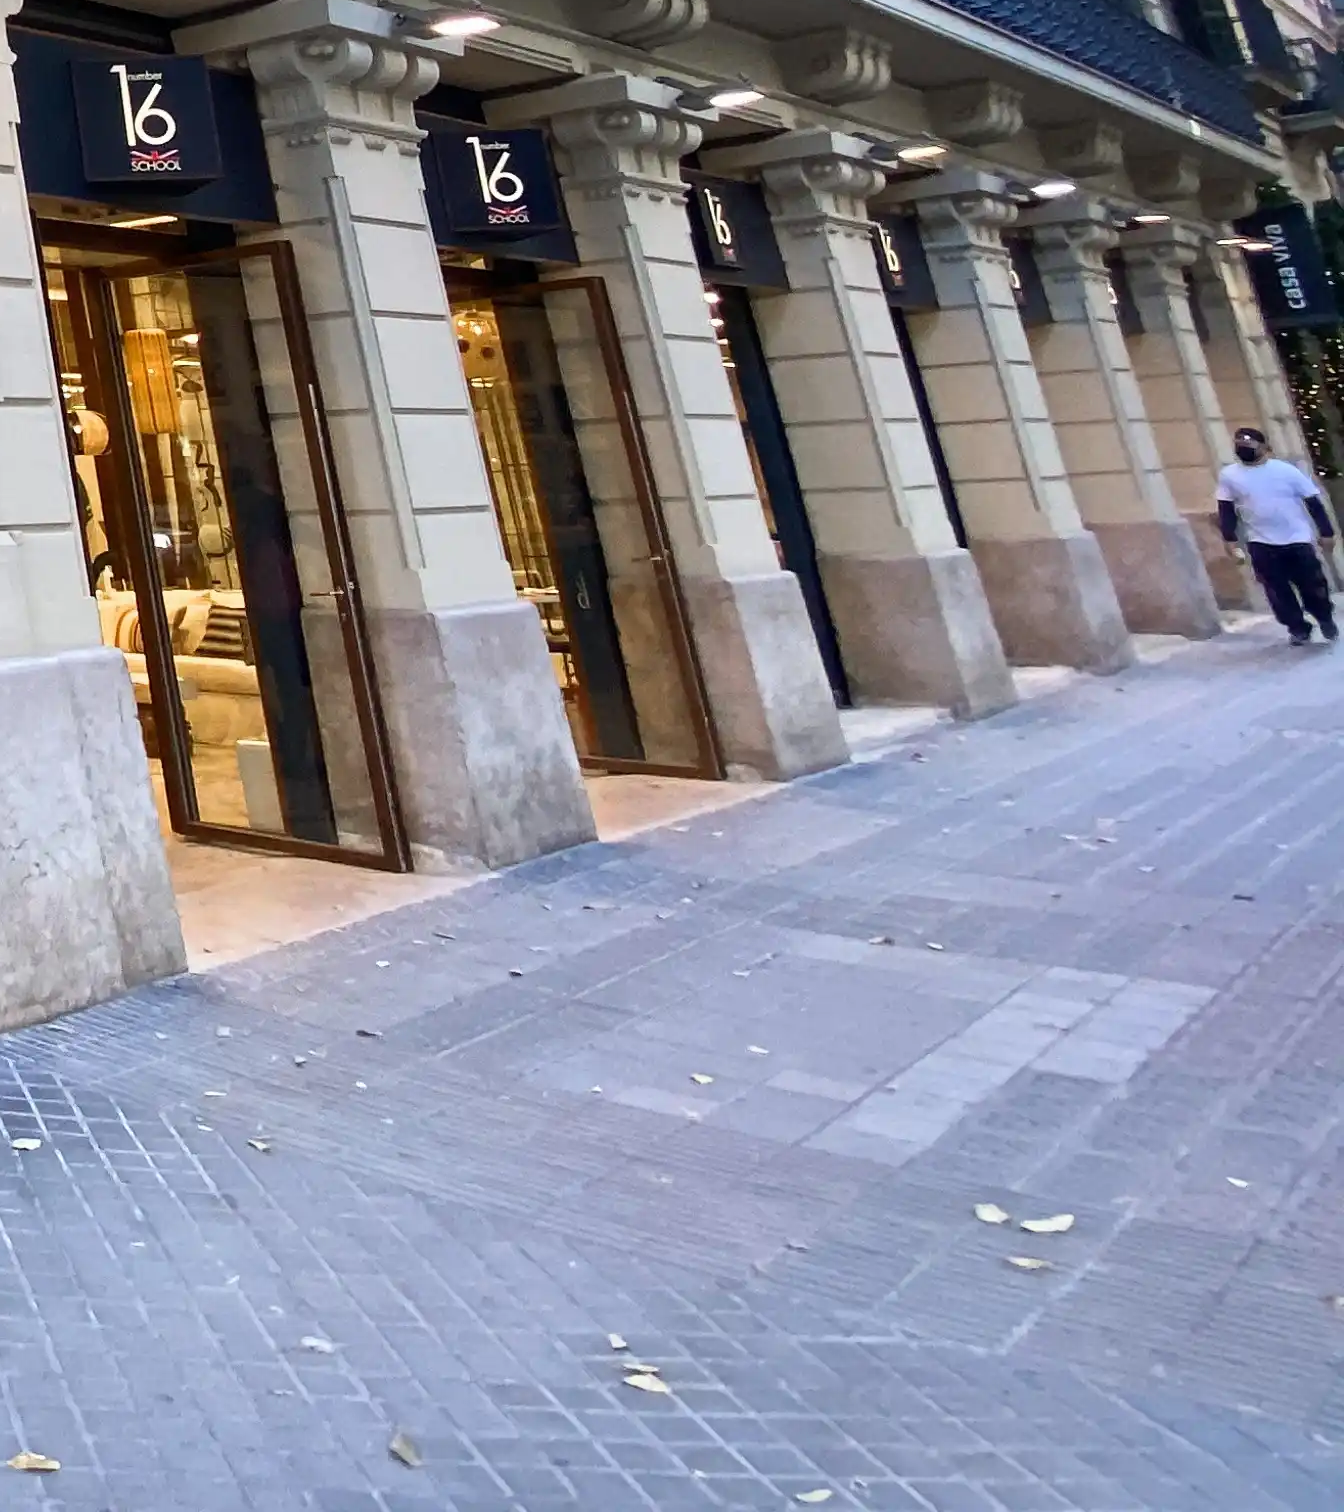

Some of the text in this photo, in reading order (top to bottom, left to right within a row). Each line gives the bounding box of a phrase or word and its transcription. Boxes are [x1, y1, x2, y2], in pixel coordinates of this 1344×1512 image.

[109, 64, 177, 147] 16
[131, 160, 182, 172] SCHOOL
[464, 136, 524, 204] 16
[1264, 224, 1307, 309] casa viva
